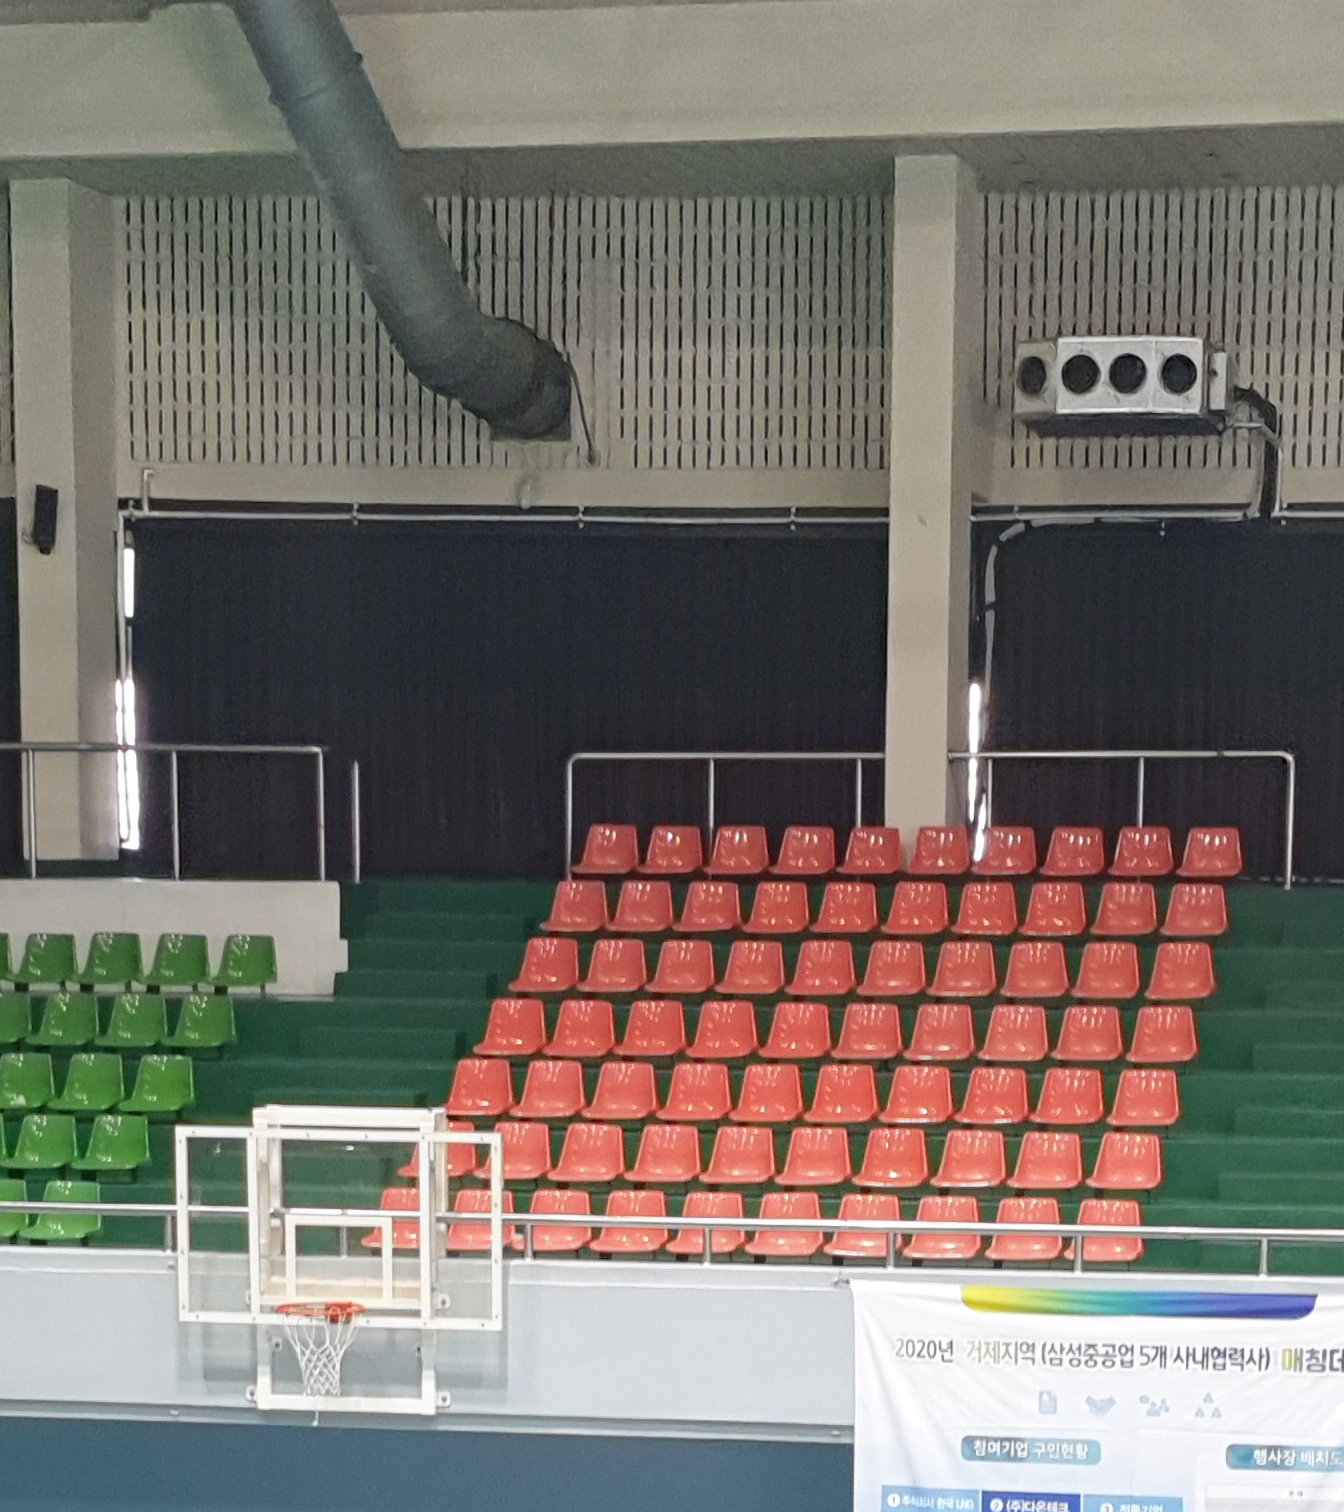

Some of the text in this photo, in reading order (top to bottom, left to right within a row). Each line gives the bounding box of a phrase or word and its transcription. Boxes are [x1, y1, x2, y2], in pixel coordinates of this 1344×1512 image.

[895, 1338, 954, 1363] 2020년
[966, 1339, 1036, 1366] 거제지역
[1041, 1341, 1135, 1369] (삼성중공업
[1139, 1344, 1168, 1370] 5개
[1173, 1345, 1271, 1372] 사내협력사)
[973, 1439, 1089, 1461] 참여기업 구인현황
[1253, 1448, 1344, 1468] 행사장 배치도
